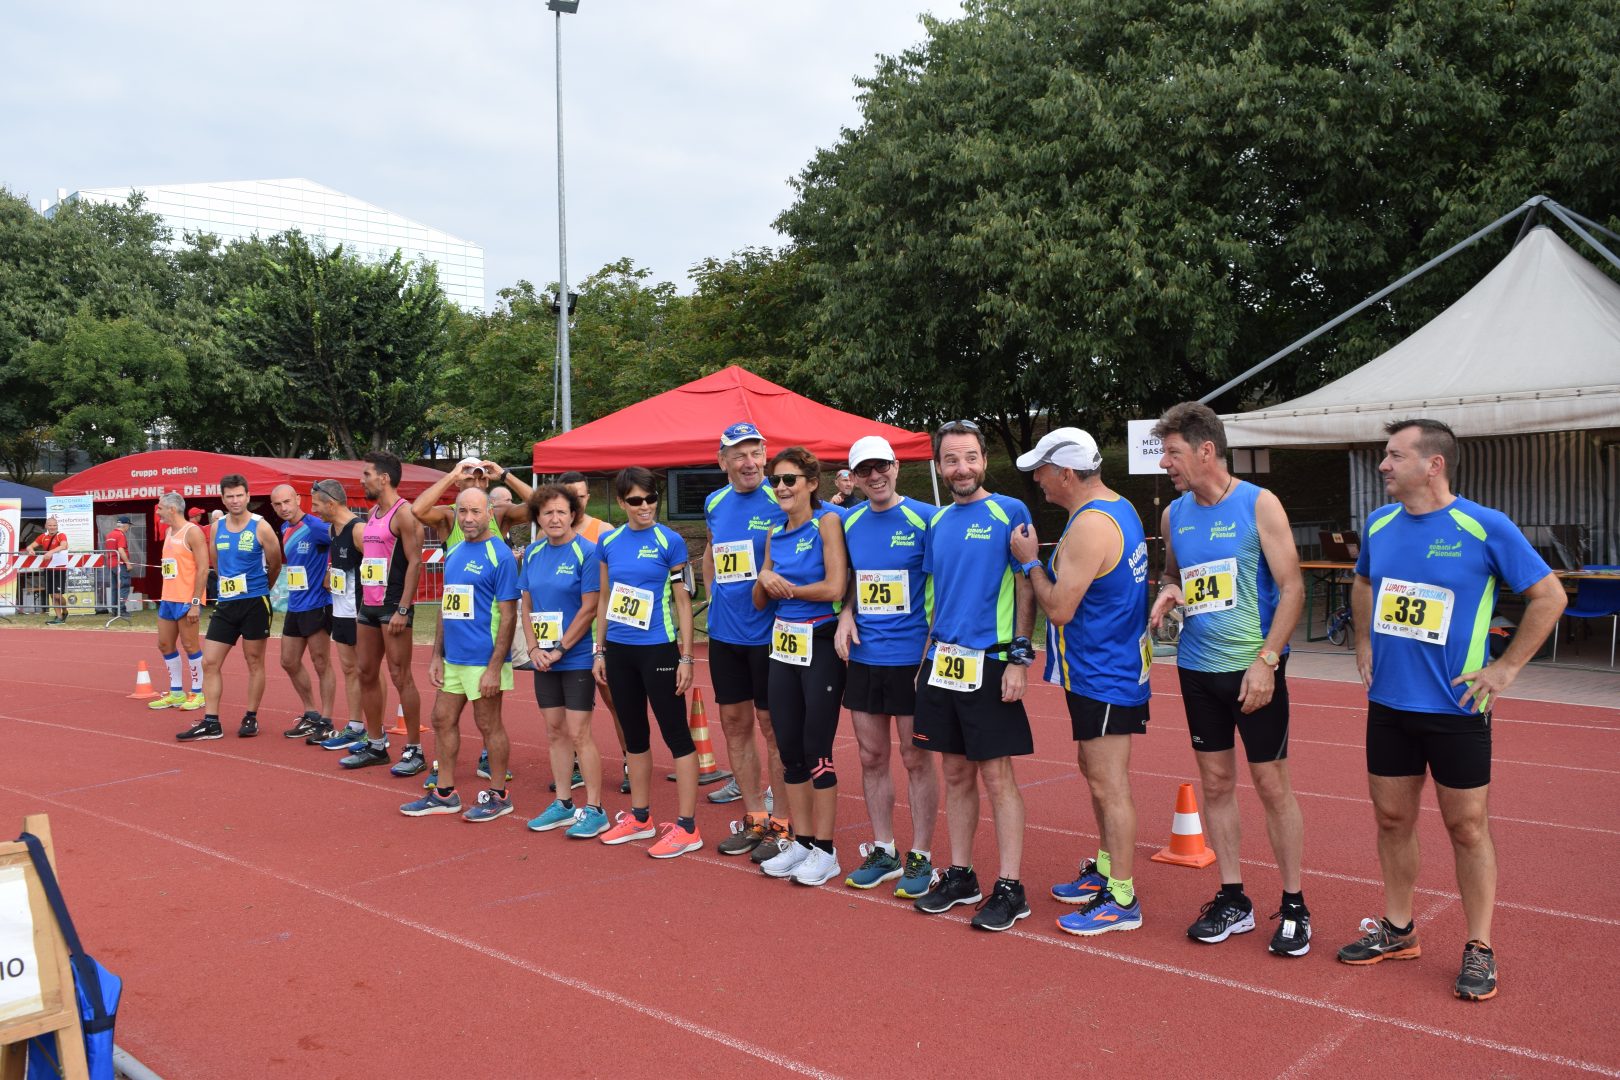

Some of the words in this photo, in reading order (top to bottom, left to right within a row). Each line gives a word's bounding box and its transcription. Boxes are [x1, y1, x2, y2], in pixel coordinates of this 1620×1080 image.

[131, 469, 158, 477] Gruppo
[161, 466, 198, 475] Podistico
[184, 484, 202, 497] DE
[367, 565, 373, 579] 5
[722, 553, 737, 572] 27
[224, 580, 236, 592] 13
[868, 583, 892, 604] 25
[1194, 575, 1220, 602] 34
[1384, 582, 1408, 594] LUPATO
[1418, 588, 1448, 602] TISSIMA
[446, 594, 461, 611] 28
[620, 595, 641, 617] 30
[1395, 595, 1427, 626] 33
[533, 622, 549, 639] 32
[780, 632, 798, 654] 26
[944, 655, 965, 680] 29
